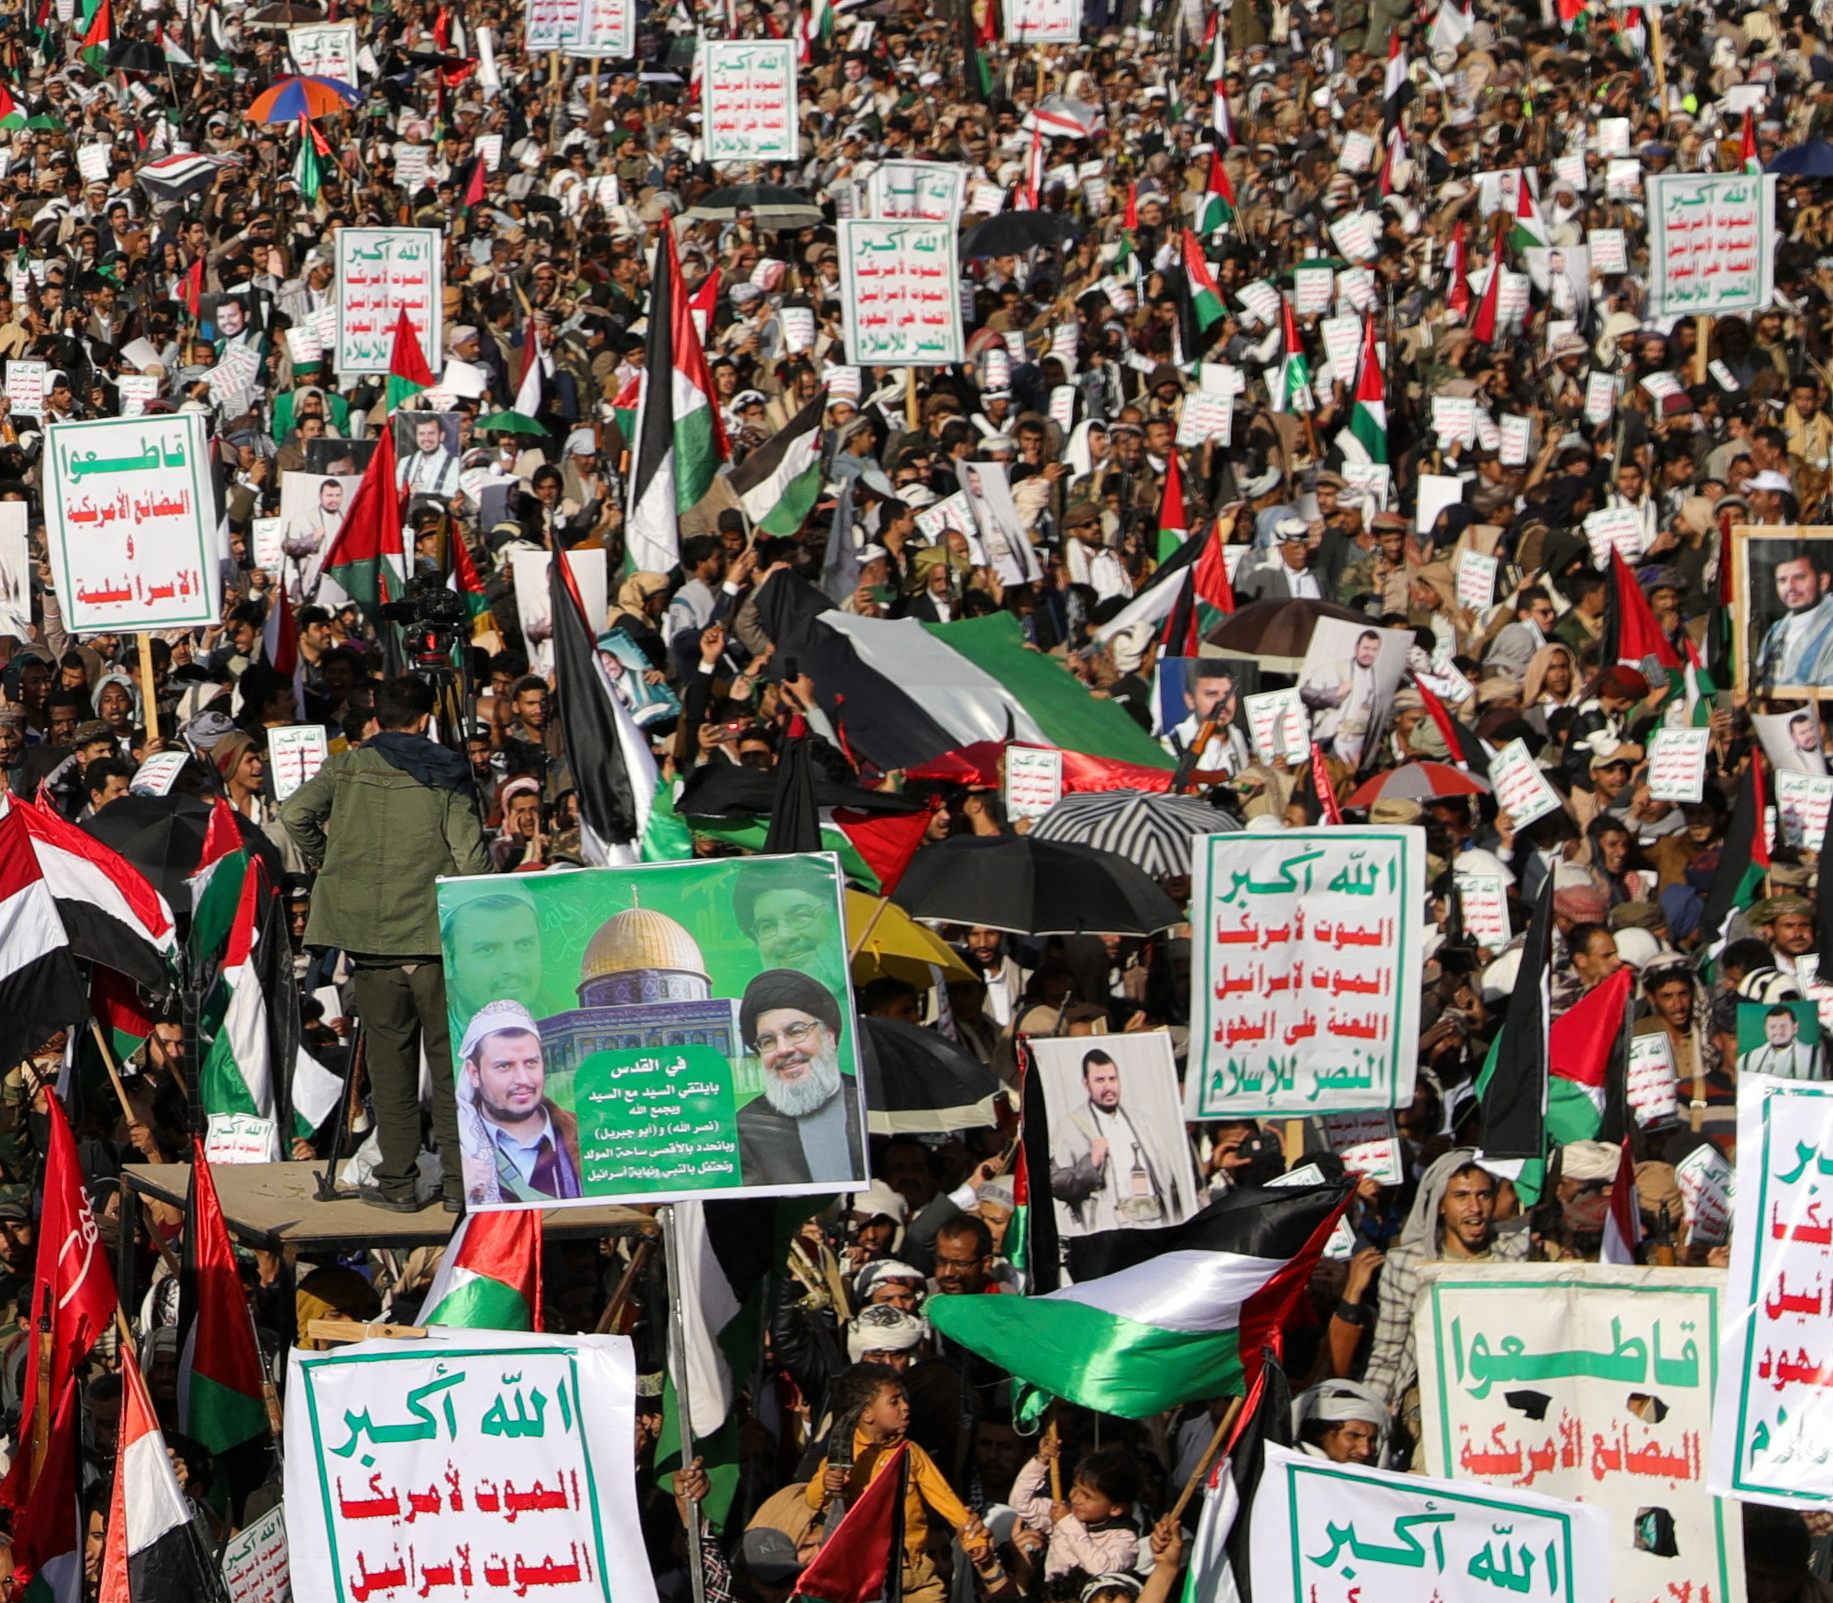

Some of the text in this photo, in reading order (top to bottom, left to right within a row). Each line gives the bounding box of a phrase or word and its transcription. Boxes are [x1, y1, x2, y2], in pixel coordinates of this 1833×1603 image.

[62, 440, 185, 483] قاطعوا
[67, 489, 189, 527] البضائع الأمريكية
[77, 571, 198, 606] الإسرائيلية
[1219, 847, 1396, 908] الله أكبر
[1314, 921, 1392, 950] الموت
[1311, 970, 1390, 996] الموت
[1215, 1011, 1387, 1049] اللعنة على اليهود
[611, 1056, 686, 1078] في القدس
[1212, 1050, 1384, 1101] النصر للإسلام
[589, 1088, 621, 1102] السيد
[625, 1090, 638, 1102] مع
[642, 1085, 675, 1099] السيد
[629, 1106, 681, 1118] ويجمع الله
[584, 1149, 613, 1160] المولد
[616, 1148, 647, 1158] ساحة
[649, 1143, 693, 1157] بالأقصى
[661, 1164, 695, 1178] بالنبي
[698, 1161, 733, 1174] ونحتفل
[1452, 1319, 1699, 1399] قاطعوا
[330, 1364, 572, 1467] الله أكبر
[1461, 1413, 1700, 1489] البضائع الأمريكية
[475, 1471, 580, 1523] الموت
